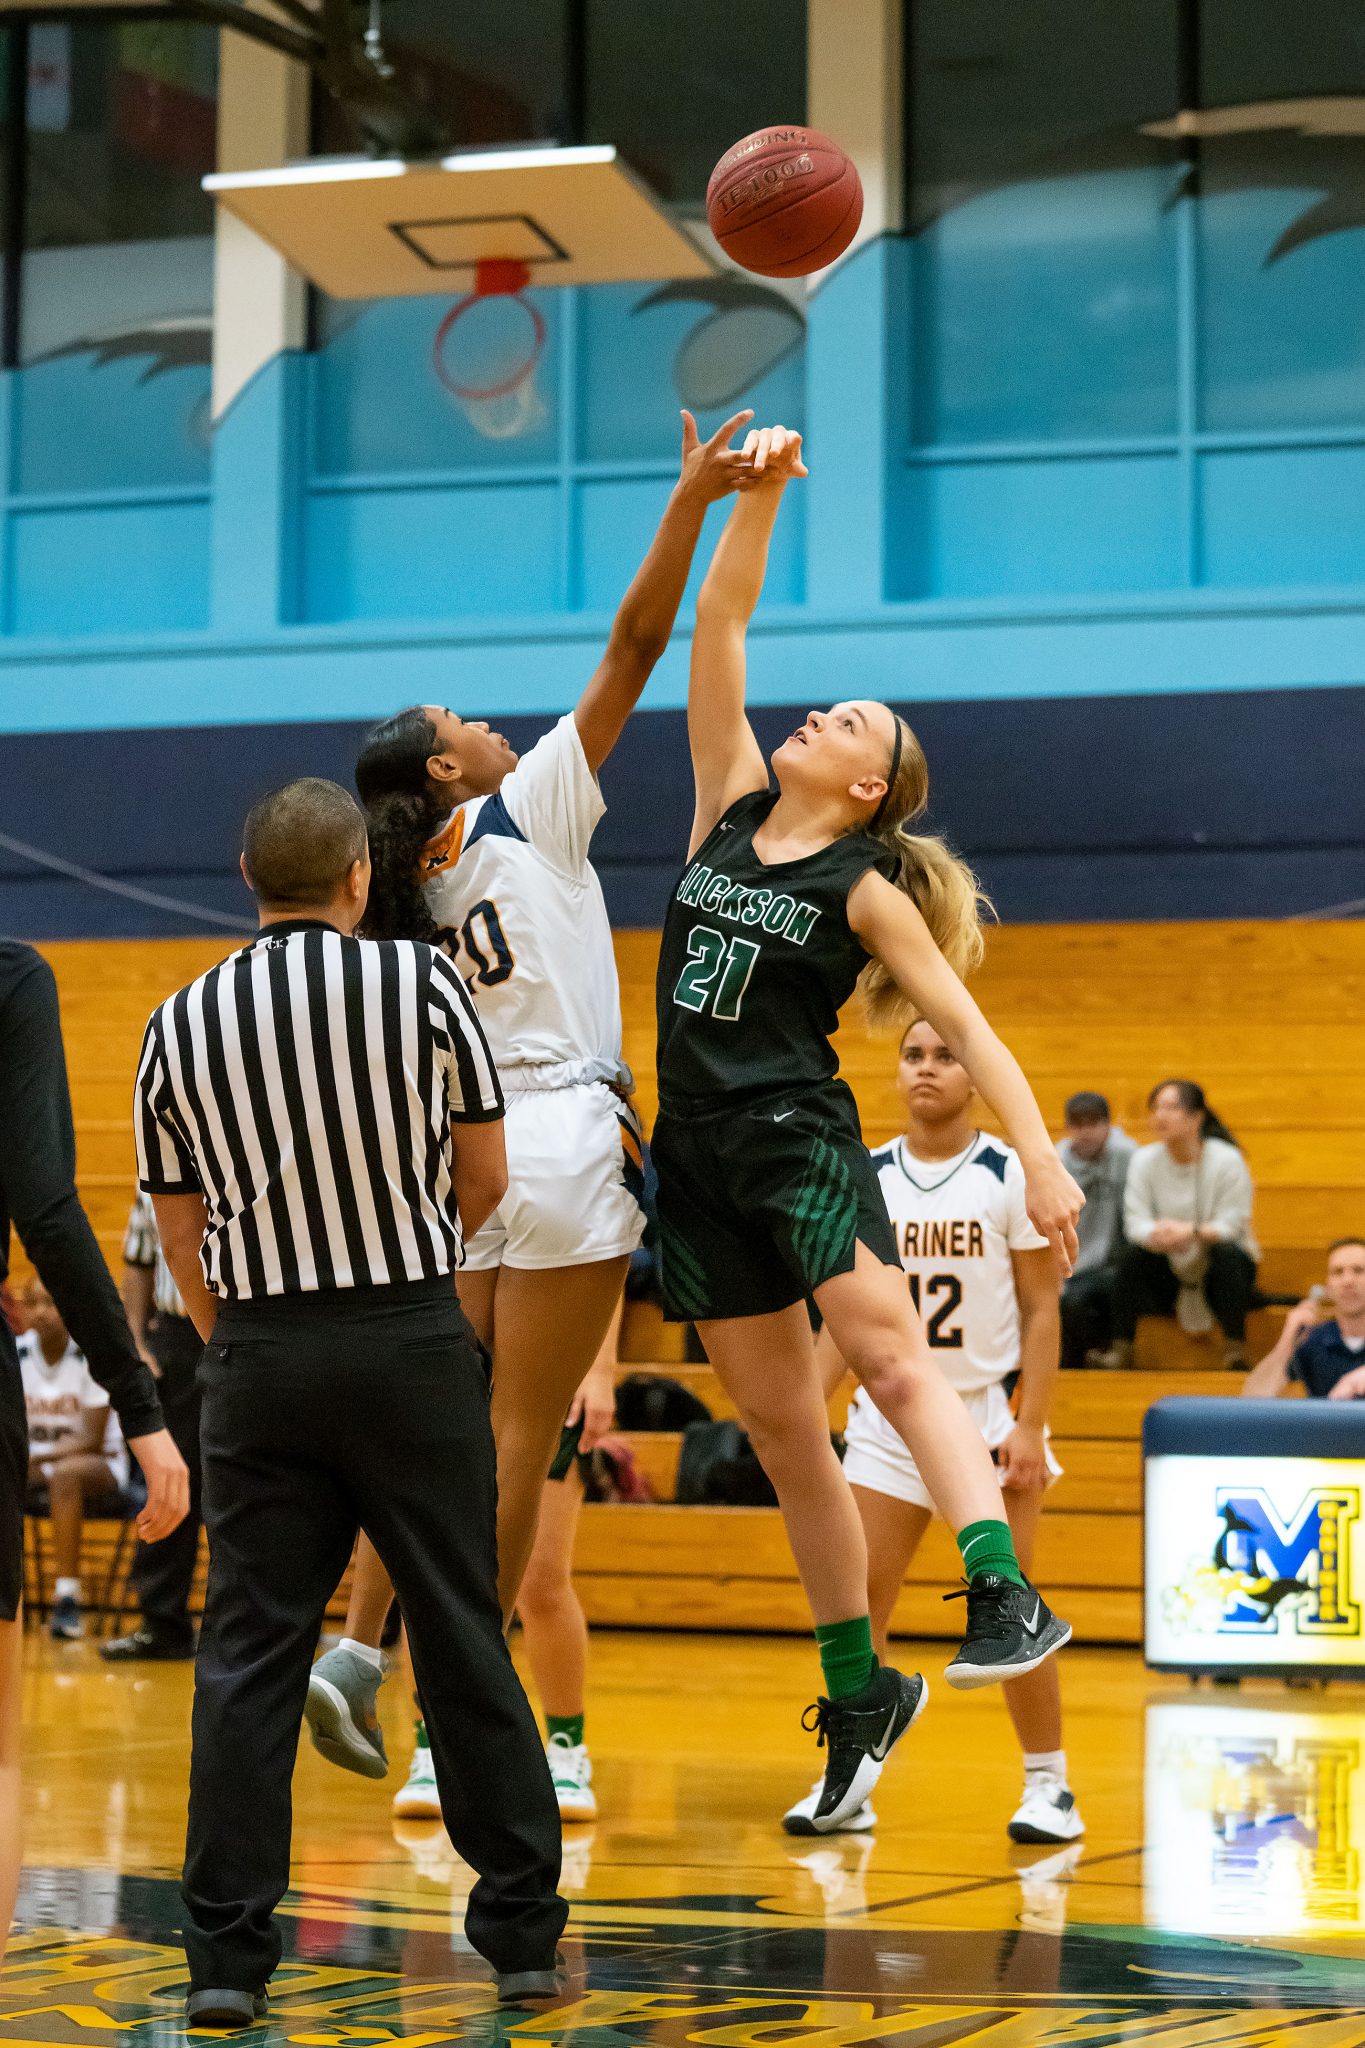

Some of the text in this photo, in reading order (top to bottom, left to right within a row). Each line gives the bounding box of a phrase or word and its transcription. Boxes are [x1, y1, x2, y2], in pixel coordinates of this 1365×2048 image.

[677, 863, 822, 946] JACKSON
[673, 924, 761, 1022] 21
[891, 1220, 985, 1258] RINER
